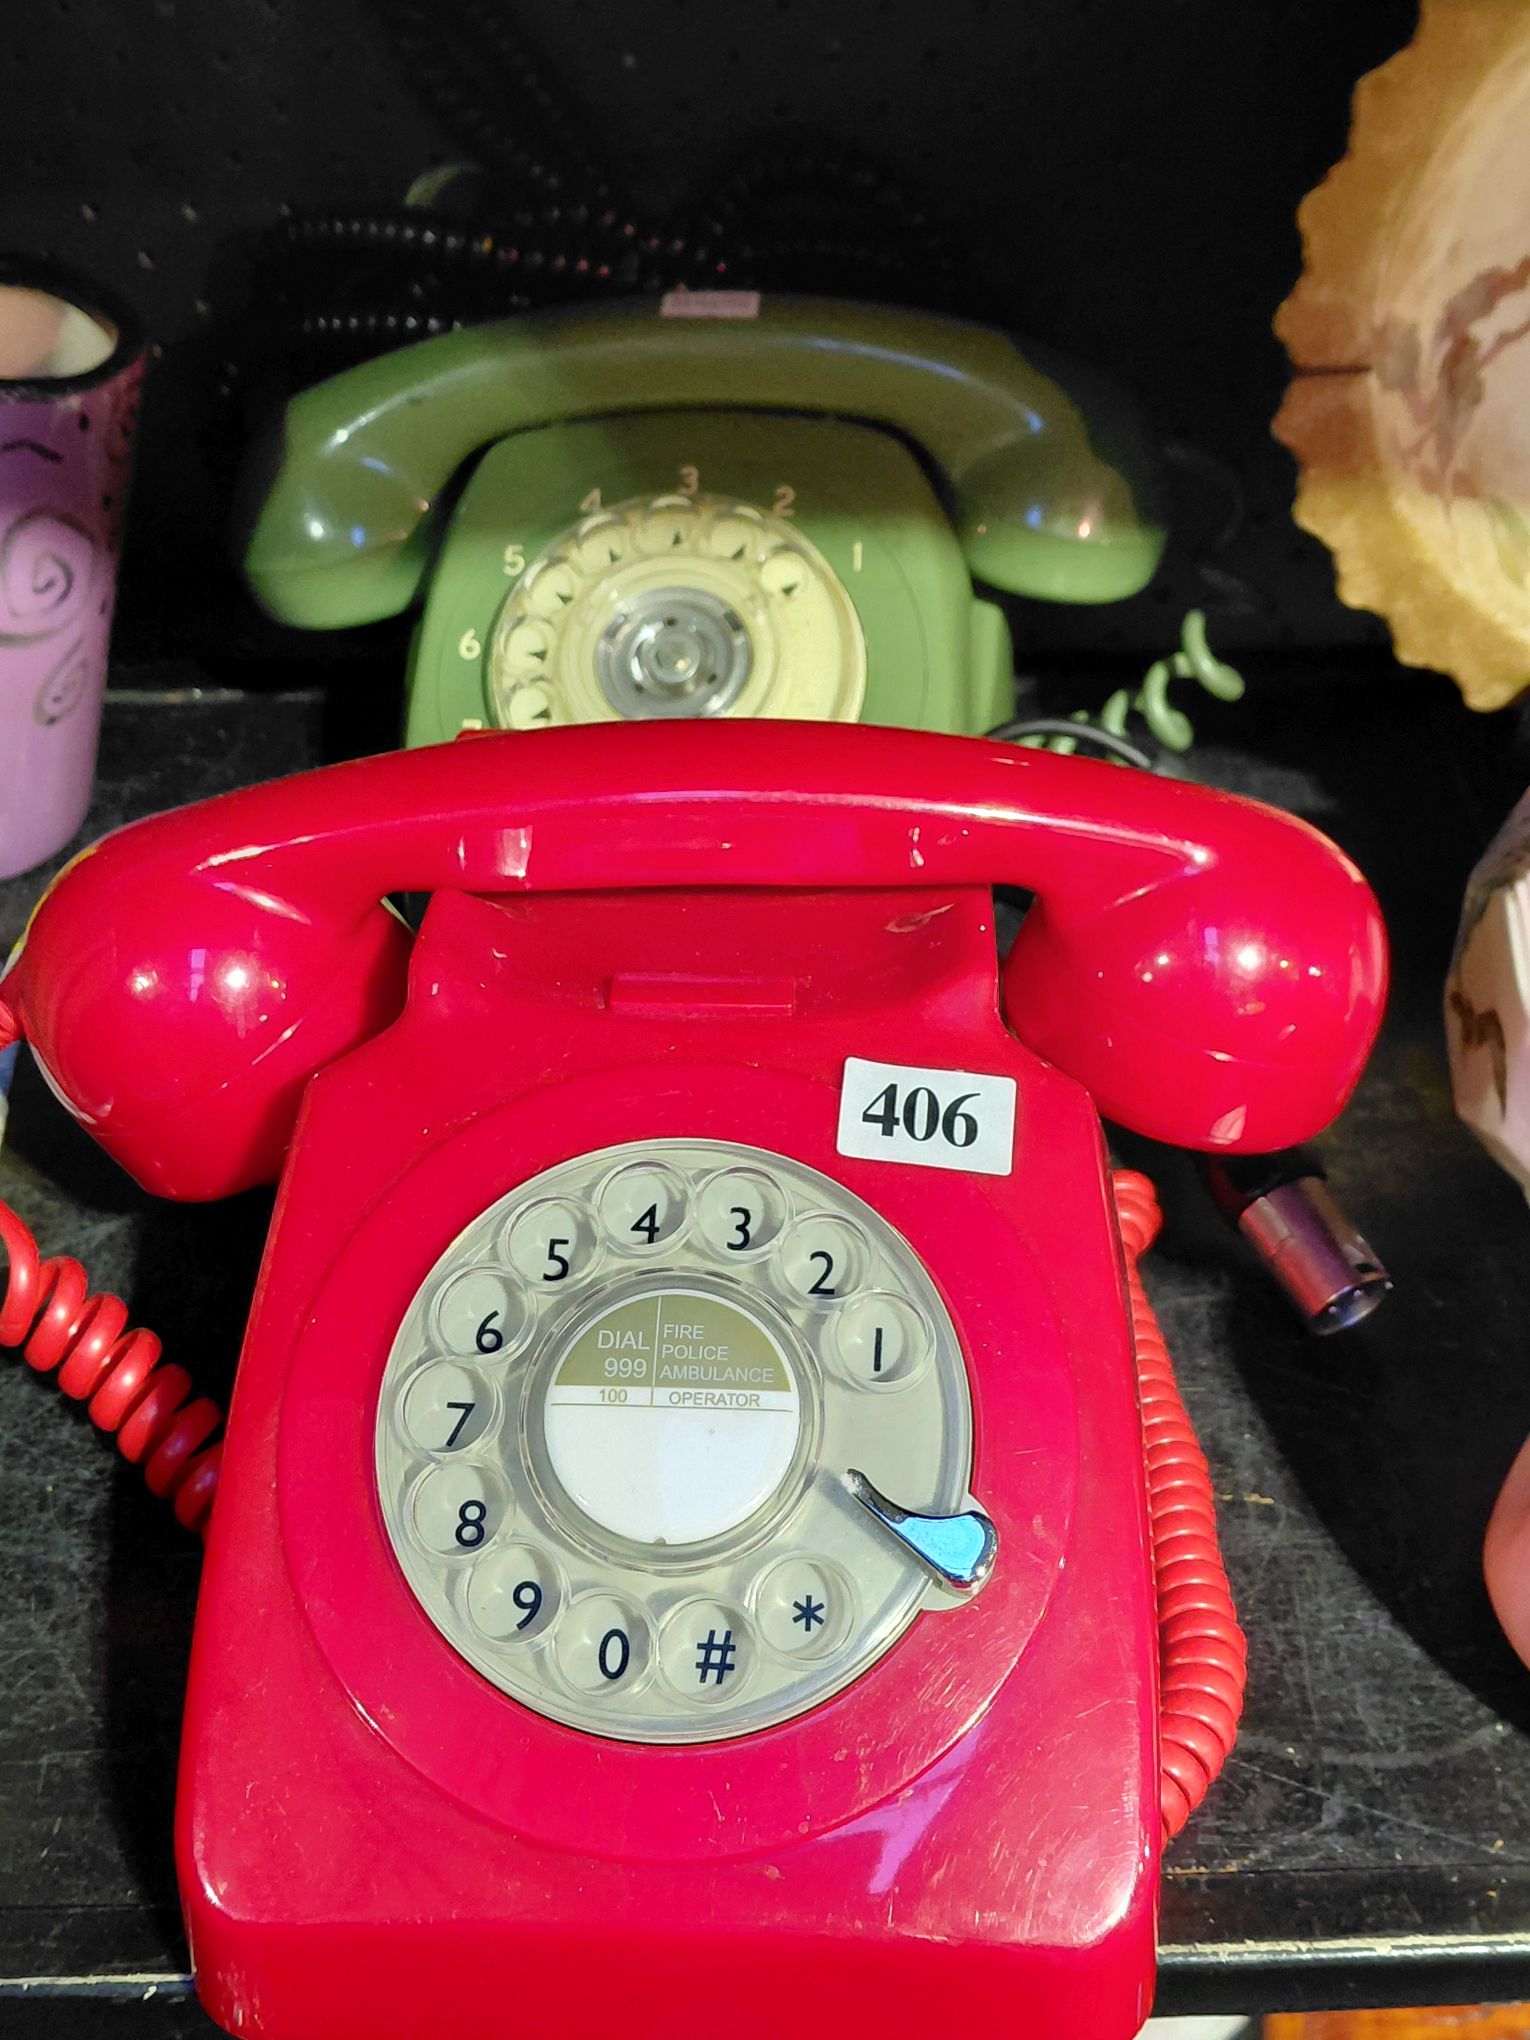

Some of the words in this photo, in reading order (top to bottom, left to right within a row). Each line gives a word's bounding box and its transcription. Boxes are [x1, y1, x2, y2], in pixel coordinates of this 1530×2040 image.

[773, 484, 796, 517] 2
[503, 545, 526, 576] 5
[458, 629, 481, 659] 6
[862, 1083, 981, 1147] 406
[631, 1204, 660, 1244] 4
[727, 1207, 752, 1250] 3
[543, 1239, 570, 1281] 5
[808, 1251, 835, 1294] 2
[475, 1310, 502, 1353] 6
[597, 1330, 650, 1350] DIAL
[663, 1324, 704, 1339] FIRE
[604, 1358, 647, 1378] 999
[661, 1345, 729, 1361] POLICE
[659, 1365, 774, 1382] AMBULANCE
[599, 1389, 628, 1403] 100
[669, 1391, 760, 1407] OPERATOR
[446, 1401, 476, 1447] 7
[455, 1500, 487, 1547] 8
[512, 1580, 543, 1630] 9
[599, 1628, 630, 1680] 0
[695, 1630, 736, 1684] #
